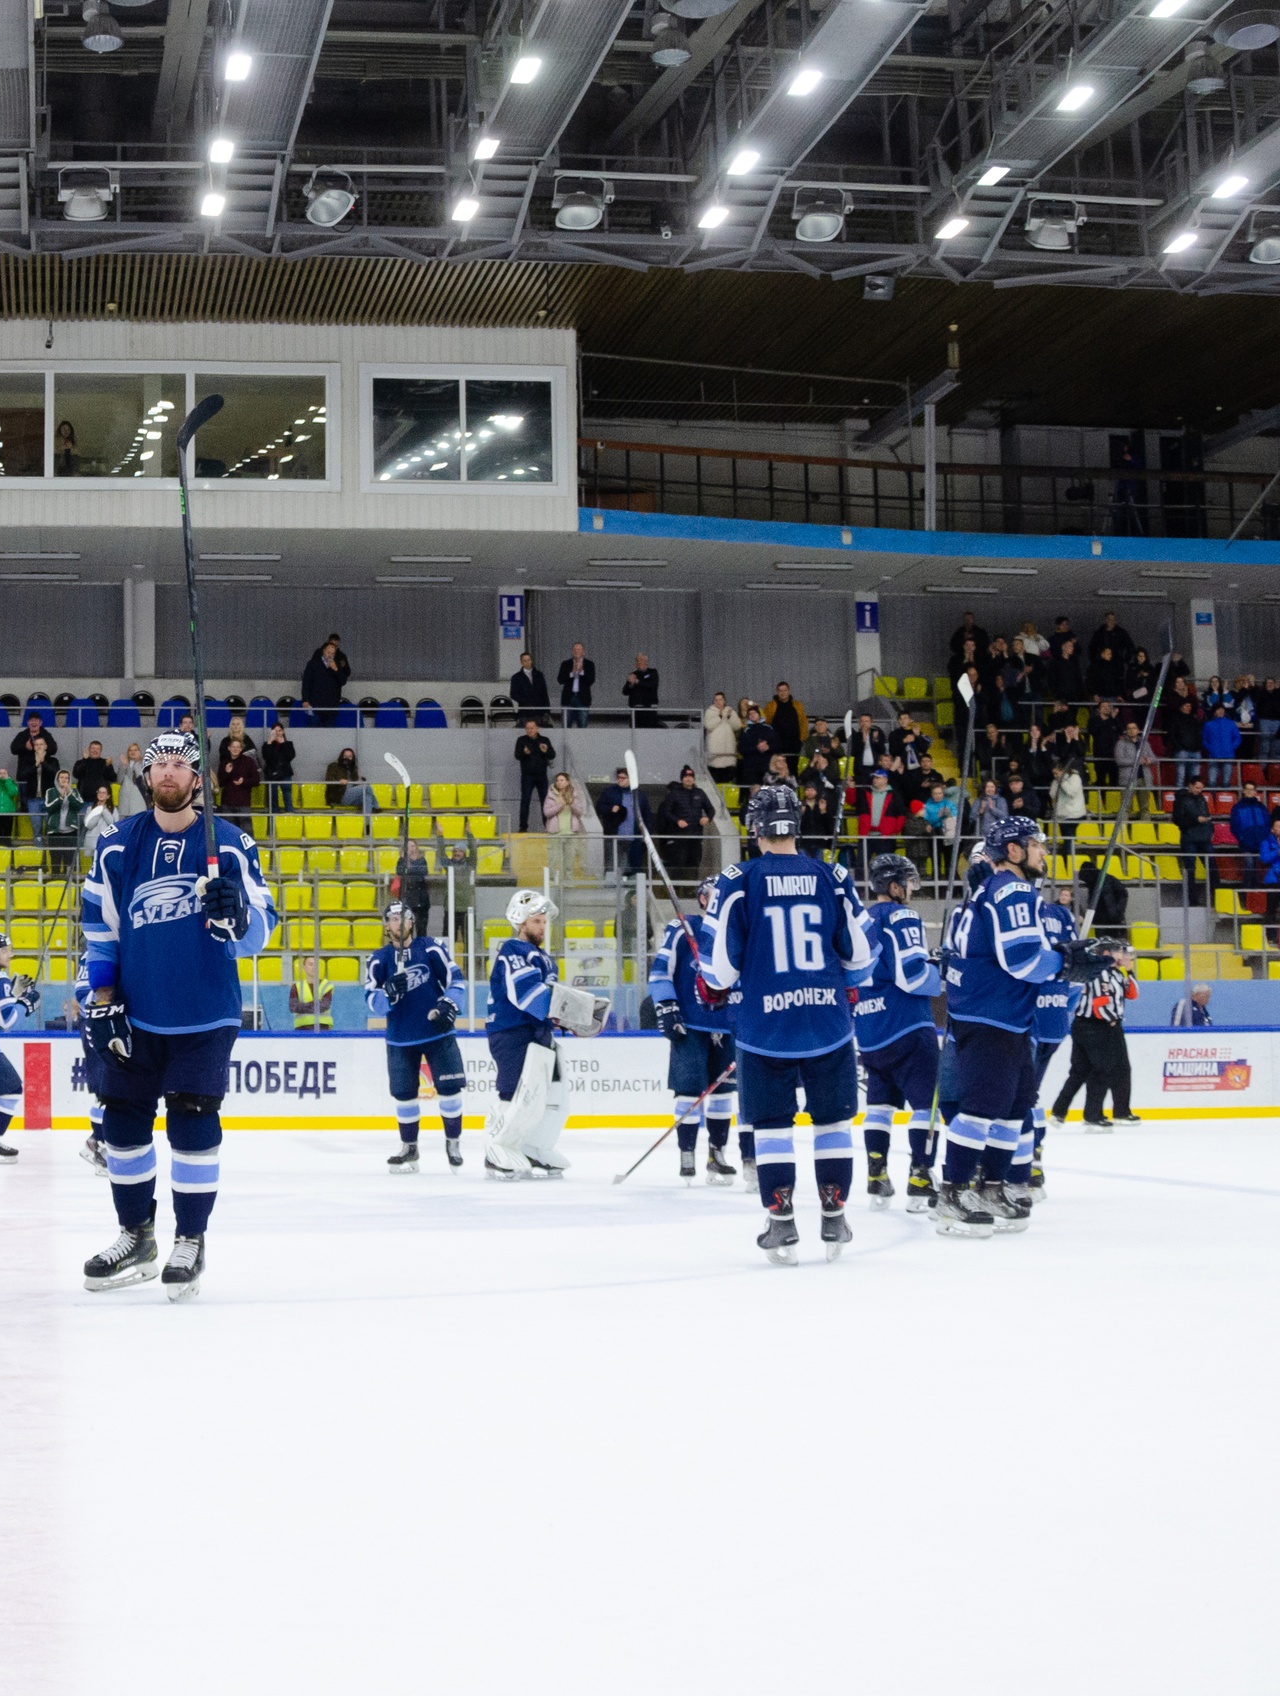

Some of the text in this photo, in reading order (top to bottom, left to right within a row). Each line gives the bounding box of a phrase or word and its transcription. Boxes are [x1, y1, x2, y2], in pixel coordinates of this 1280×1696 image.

[502, 597, 521, 620] H
[864, 604, 871, 627] i
[776, 822, 789, 834] 16
[765, 876, 817, 896] TIMIROV
[1007, 903, 1030, 928] 18
[764, 904, 825, 973] 16
[763, 988, 837, 1013] ВОРОНЕЖ
[1165, 1062, 1219, 1076] МАШИНА
[591, 1080, 661, 1092] ОБЛАСТИ
